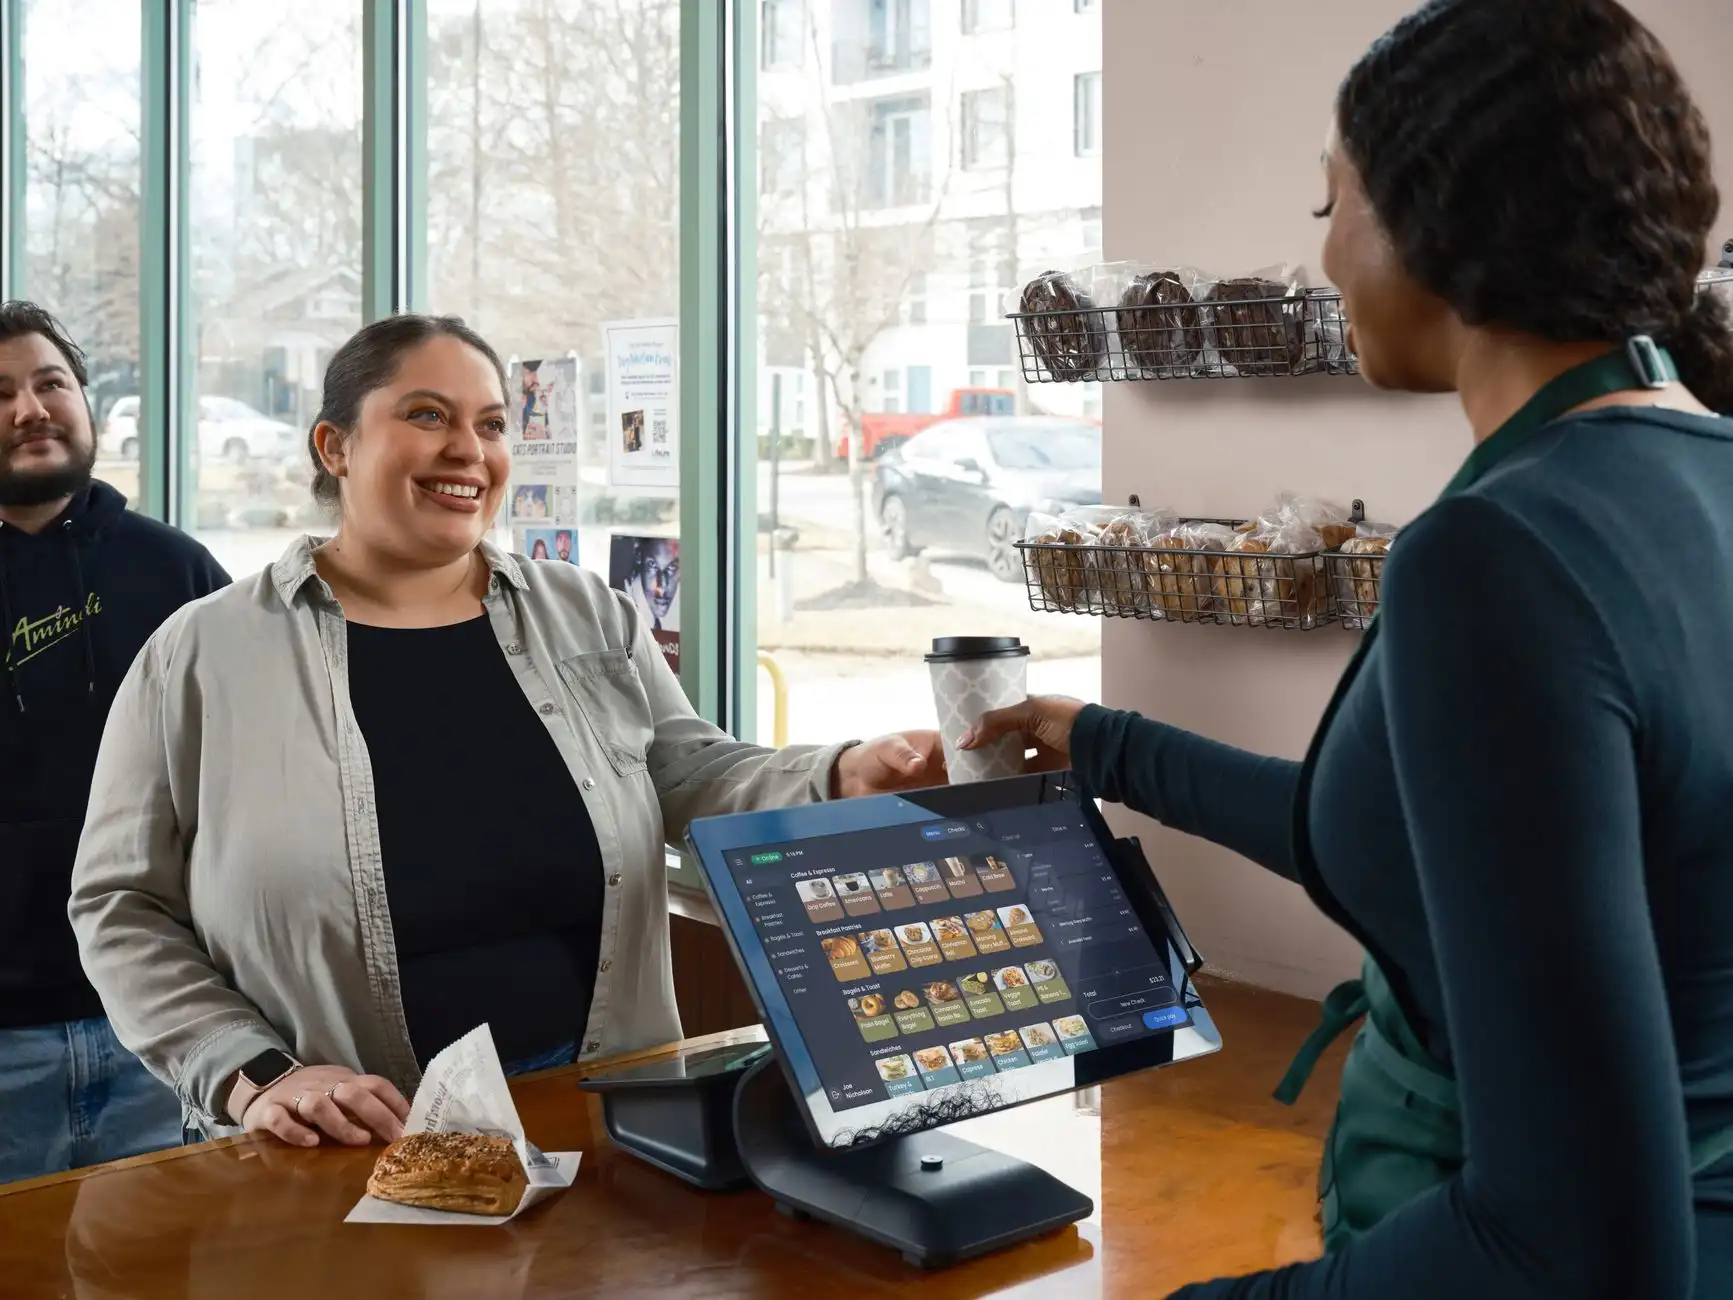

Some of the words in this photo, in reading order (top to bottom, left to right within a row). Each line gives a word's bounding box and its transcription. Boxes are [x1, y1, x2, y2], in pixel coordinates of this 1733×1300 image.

[790, 869, 808, 879] Coffee
[813, 867, 836, 877] Espresso
[807, 902, 819, 911] Drip
[819, 901, 836, 909] Coffee
[816, 927, 841, 937] Breakfast
[841, 923, 862, 932] Pastries
[842, 987, 861, 996] Bagels
[865, 983, 881, 991] Toast
[1083, 989, 1097, 998] Total
[934, 1004, 961, 1014] Cinnamon
[897, 1010, 926, 1022] Everything
[1110, 1023, 1133, 1034] Checkout
[870, 1045, 902, 1057] Sandwiches
[962, 1064, 984, 1074] Caprese
[842, 1083, 853, 1091] Joe
[888, 1083, 908, 1092] Turkey
[845, 1088, 873, 1100] Nicholson
